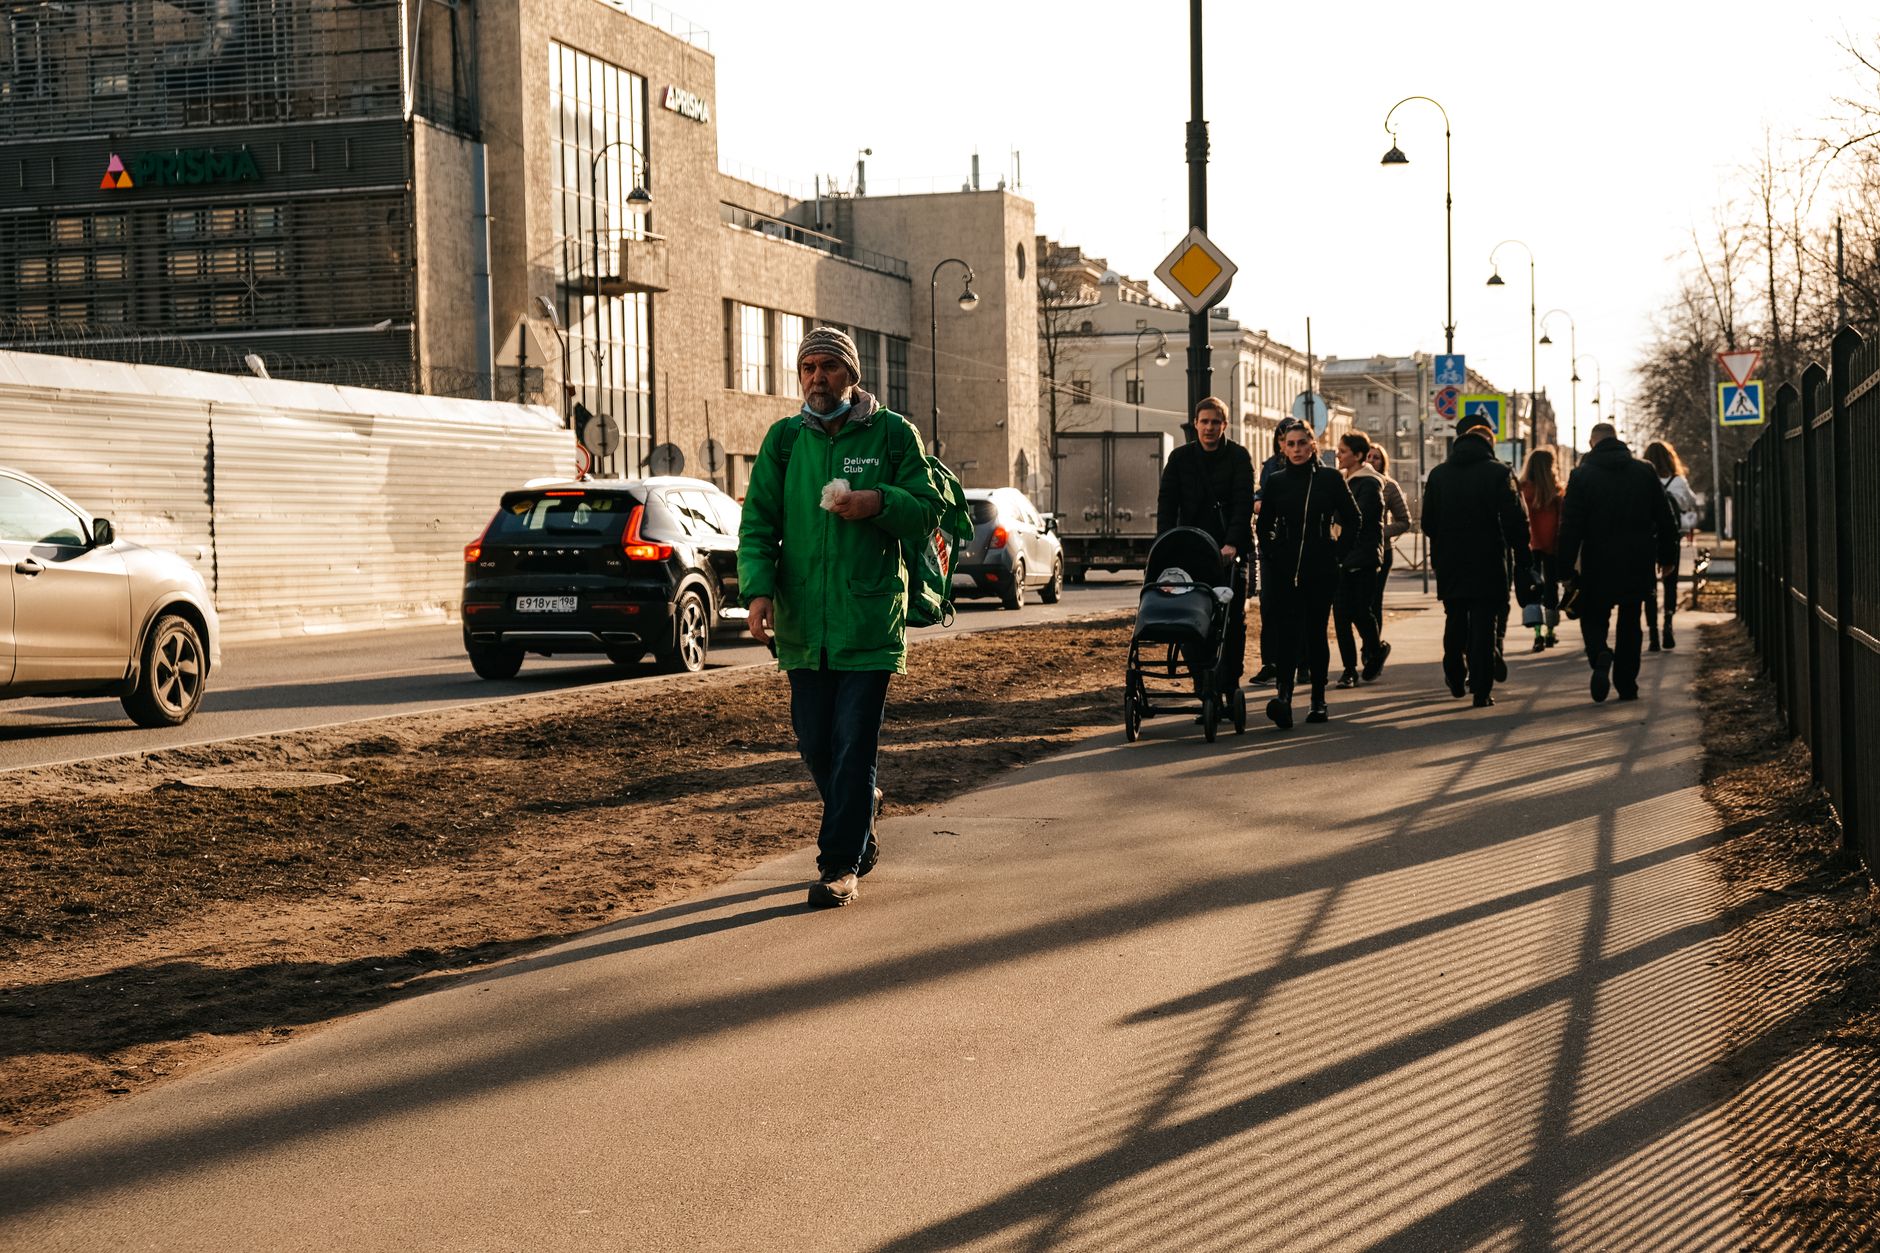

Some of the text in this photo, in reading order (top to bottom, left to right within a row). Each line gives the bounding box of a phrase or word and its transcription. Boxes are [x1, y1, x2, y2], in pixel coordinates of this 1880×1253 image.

[675, 87, 710, 123] PRISMA
[134, 148, 260, 186] PRISMA
[844, 457, 879, 466] Delivery
[560, 597, 575, 605] 198
